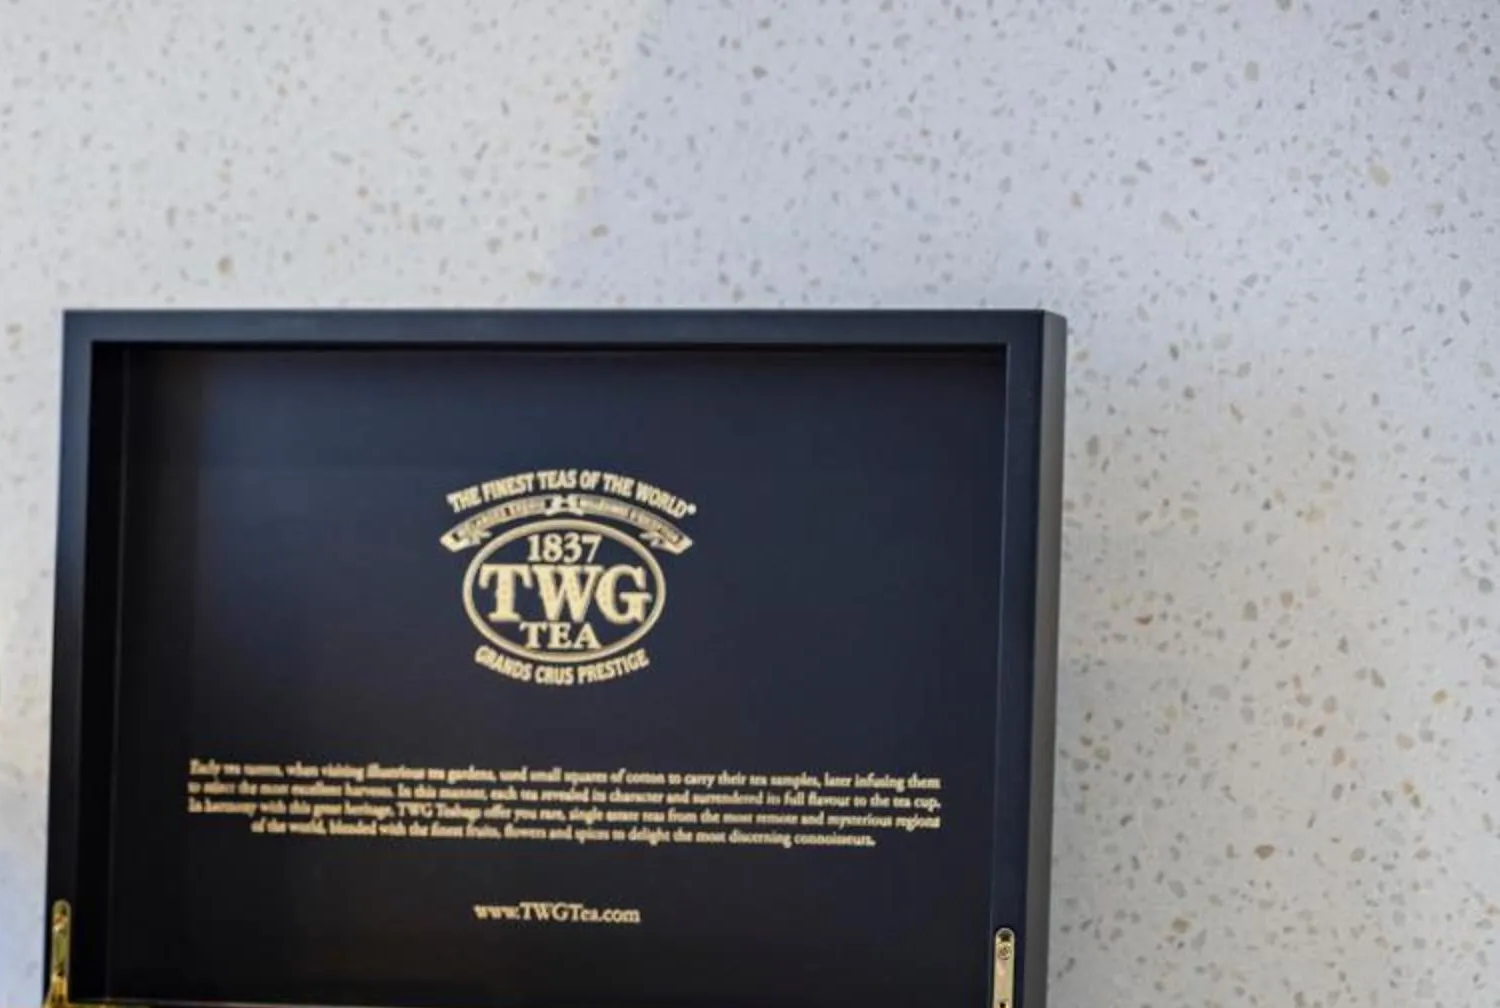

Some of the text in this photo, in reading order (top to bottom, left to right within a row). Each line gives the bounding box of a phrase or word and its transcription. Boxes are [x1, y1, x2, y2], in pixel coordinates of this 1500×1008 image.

[447, 469, 688, 519] THE FINEST TEAS OF THE WORLD
[527, 532, 603, 563] 1837
[478, 563, 652, 625] TWG
[519, 621, 601, 650] TEA
[577, 648, 650, 685] PRESTIGE
[610, 768, 625, 782] of
[684, 773, 714, 787] carry
[718, 770, 745, 785] their
[854, 773, 904, 791] infusing
[908, 773, 940, 788] them
[784, 791, 805, 805] full
[808, 791, 850, 806] flavour
[870, 793, 889, 806] the
[472, 901, 642, 924] www.TWGTea.com
